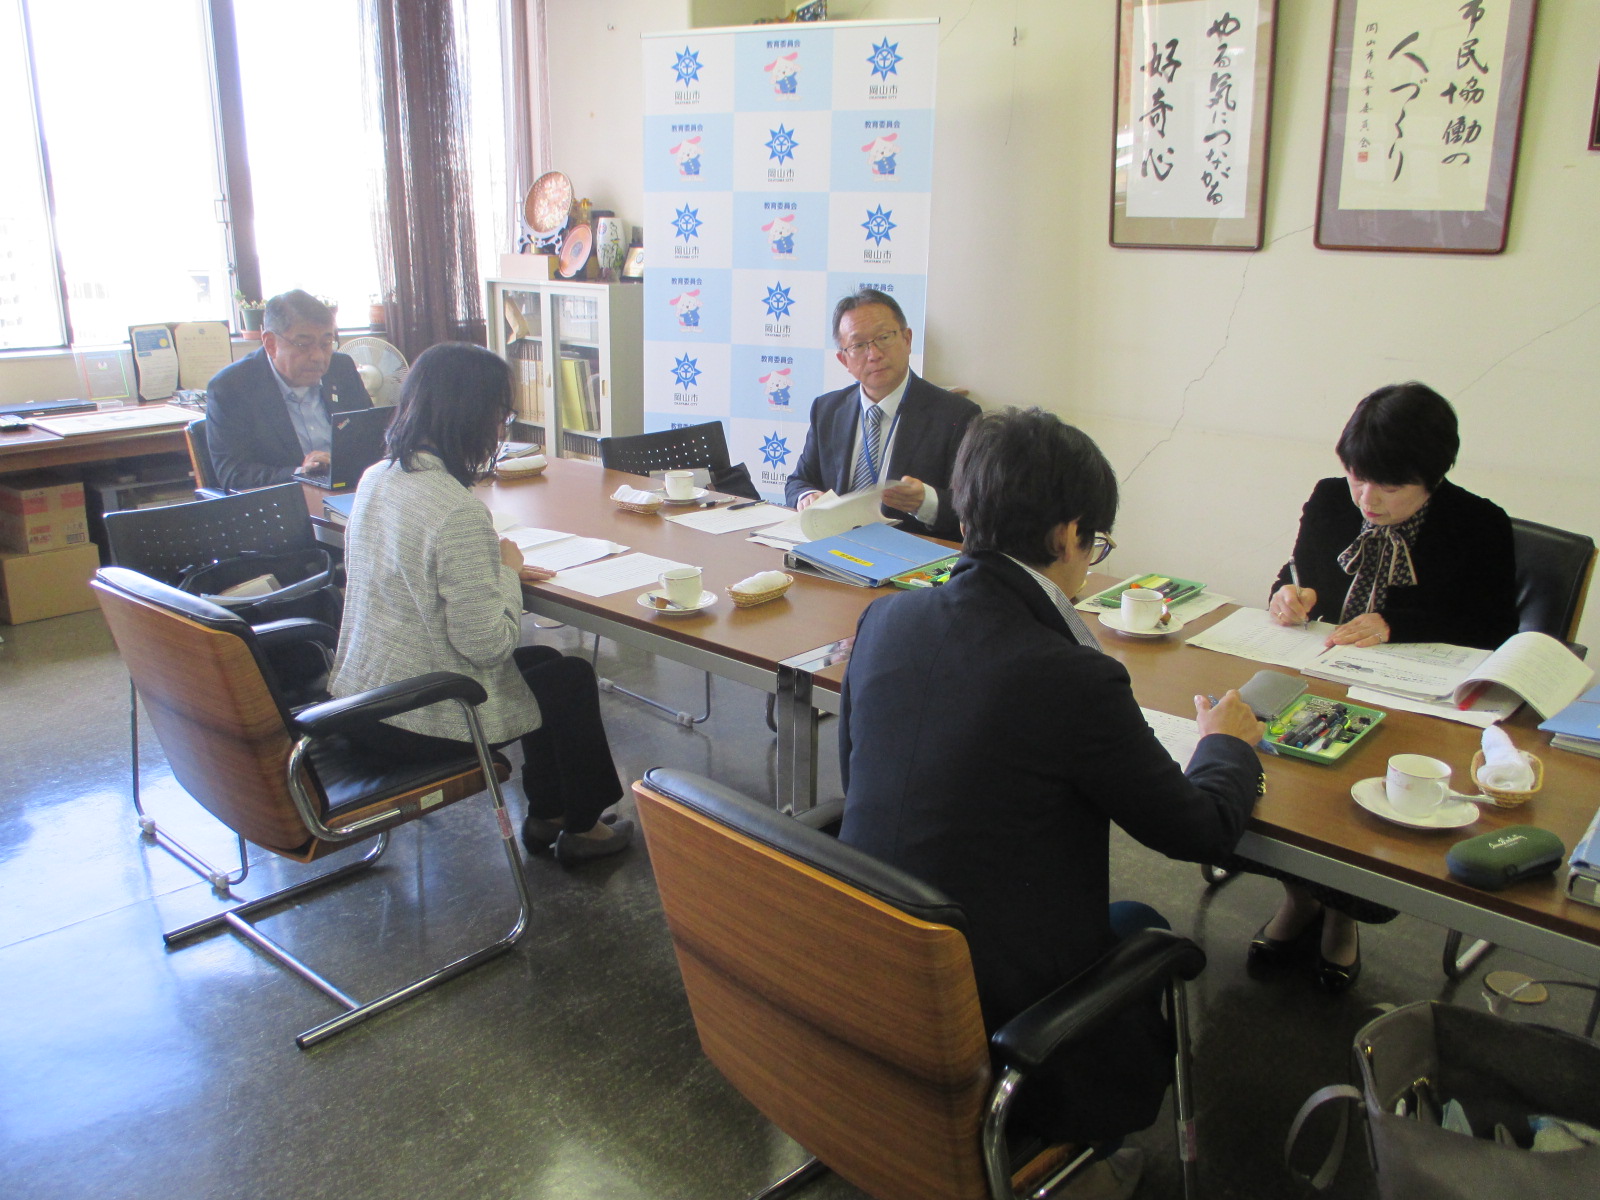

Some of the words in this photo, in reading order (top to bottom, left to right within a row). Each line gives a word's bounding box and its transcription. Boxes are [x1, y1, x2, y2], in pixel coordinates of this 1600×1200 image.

[1139, 38, 1182, 182] 好奇心
[1387, 31, 1430, 183] 人づくり
[863, 249, 892, 259] 岡山市
[764, 323, 791, 333] 岡山市
[761, 355, 794, 365] 教育委員会
